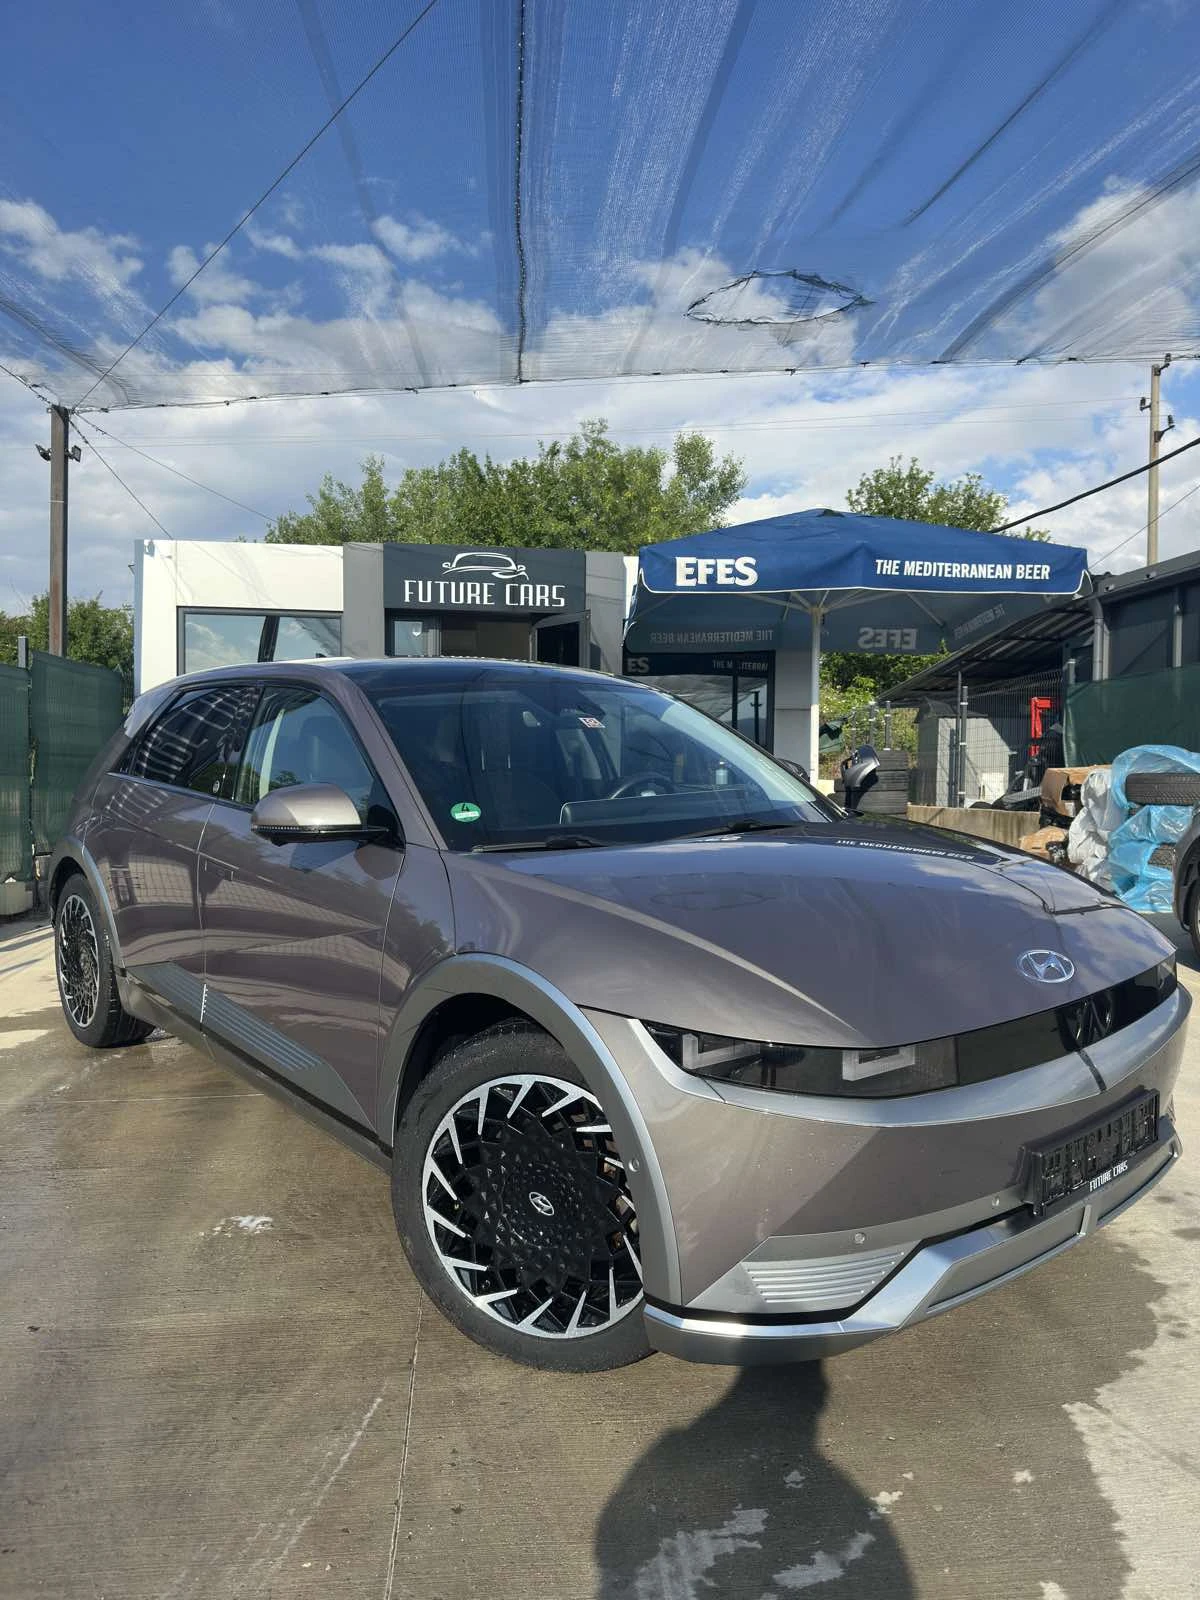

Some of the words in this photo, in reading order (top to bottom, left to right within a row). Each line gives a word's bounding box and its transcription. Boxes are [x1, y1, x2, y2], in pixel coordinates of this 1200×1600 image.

[675, 556, 759, 587] EFES
[875, 559, 901, 576] THE
[903, 560, 1012, 580] MEDITERRANEAN
[1015, 563, 1051, 580] BEER
[403, 579, 495, 606] FUTURE
[505, 582, 566, 608] CARS
[1089, 1169, 1112, 1192] FUTURE
[1113, 1160, 1128, 1177] CARS
